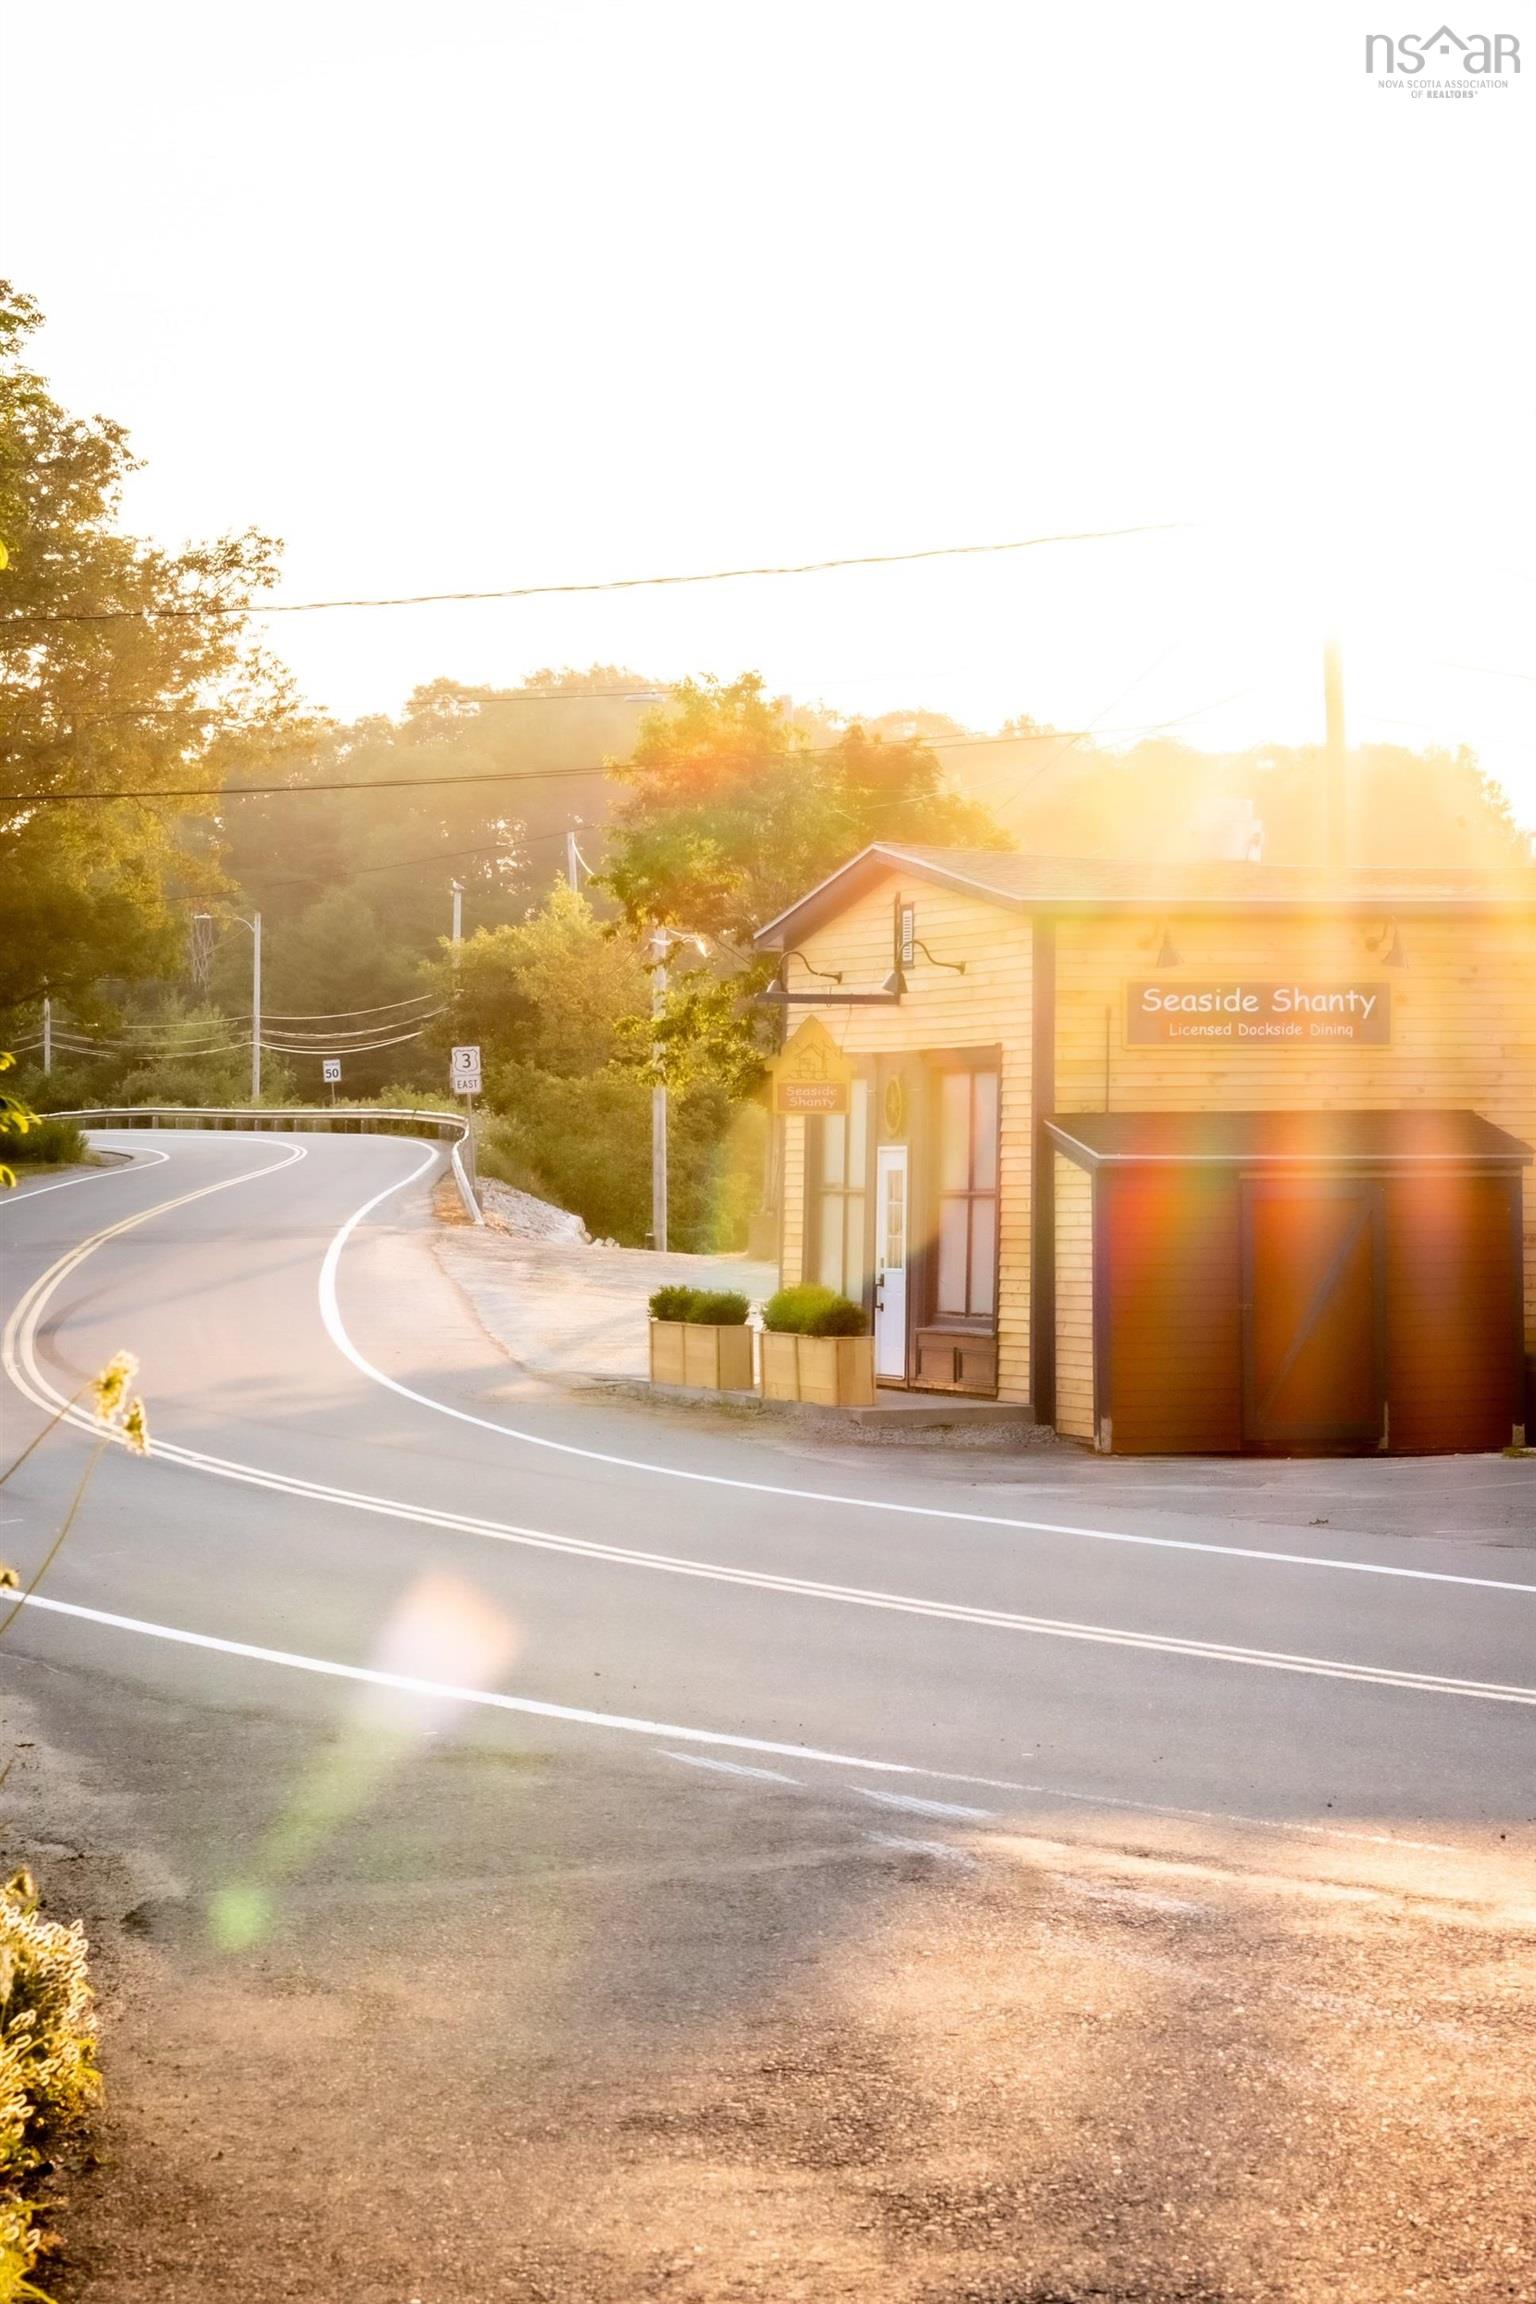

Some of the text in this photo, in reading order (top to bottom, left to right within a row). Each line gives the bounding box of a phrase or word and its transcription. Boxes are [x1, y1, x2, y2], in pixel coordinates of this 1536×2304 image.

[1141, 988, 1377, 1019] Seaside Shanty
[1169, 1022, 1354, 1037] Licensed Dockside Dining
[462, 1053, 471, 1068] 3
[325, 1068, 339, 1078] 50
[457, 1079, 478, 1089] EAST
[786, 1086, 838, 1096] Seaside
[789, 1096, 836, 1108] Shanty
